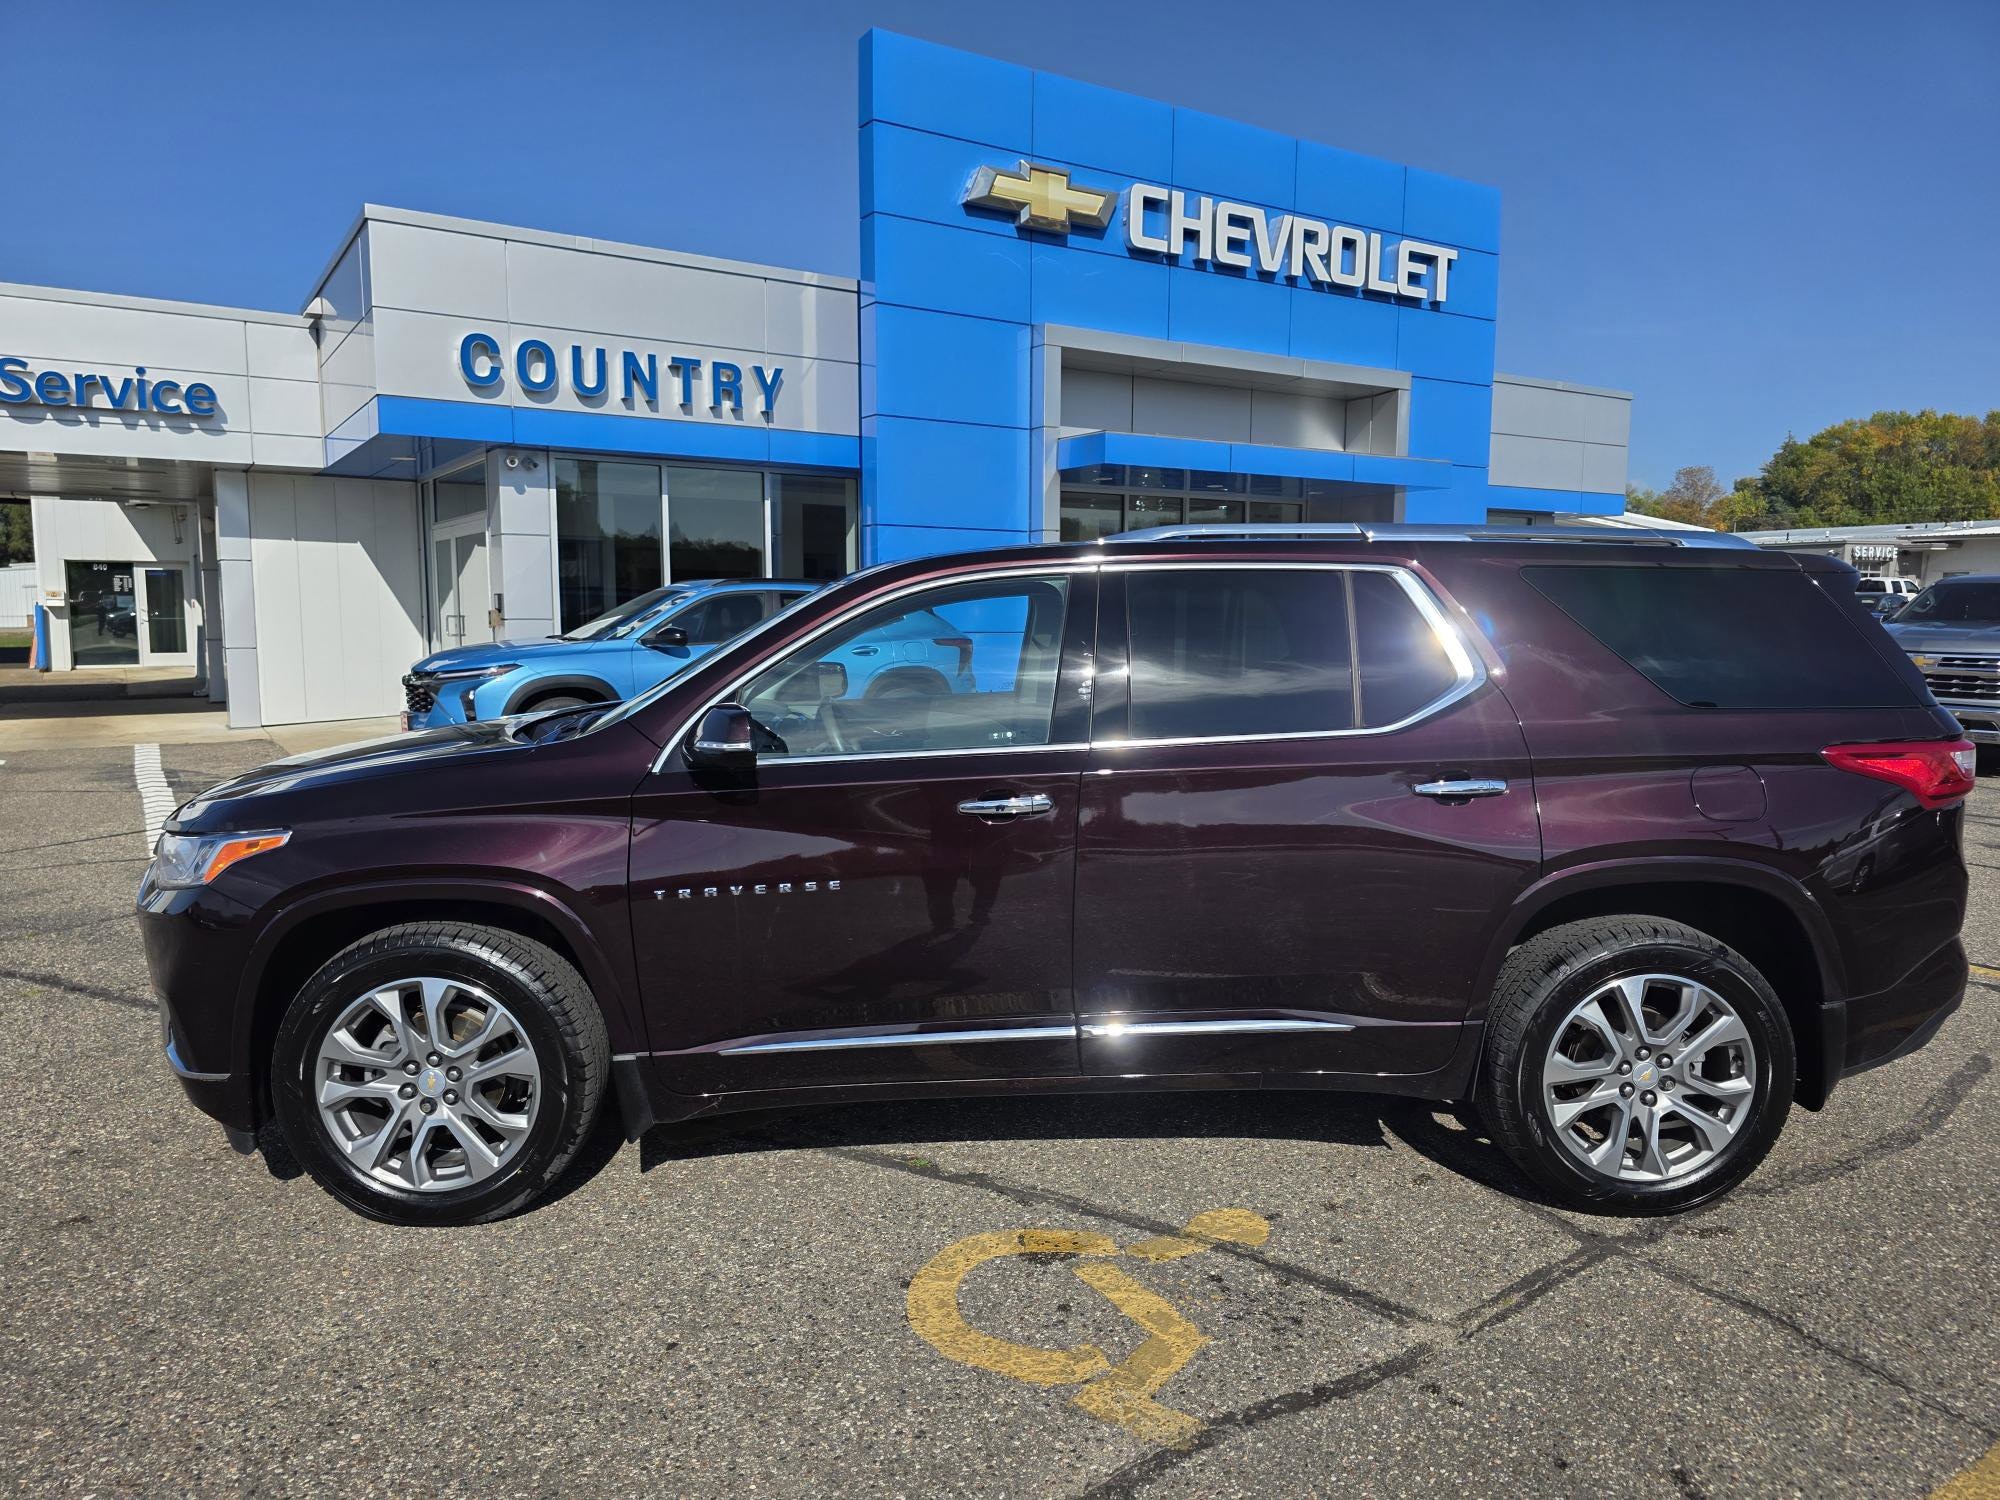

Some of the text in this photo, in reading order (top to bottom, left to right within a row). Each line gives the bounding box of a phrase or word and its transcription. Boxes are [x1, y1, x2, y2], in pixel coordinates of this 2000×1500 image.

[1124, 183, 1459, 303] CHEVROLET
[0, 357, 218, 417] Service
[459, 332, 785, 415] COUNTRY
[1854, 545, 1899, 559] SERVICE
[653, 880, 842, 901] TRAVERSE
